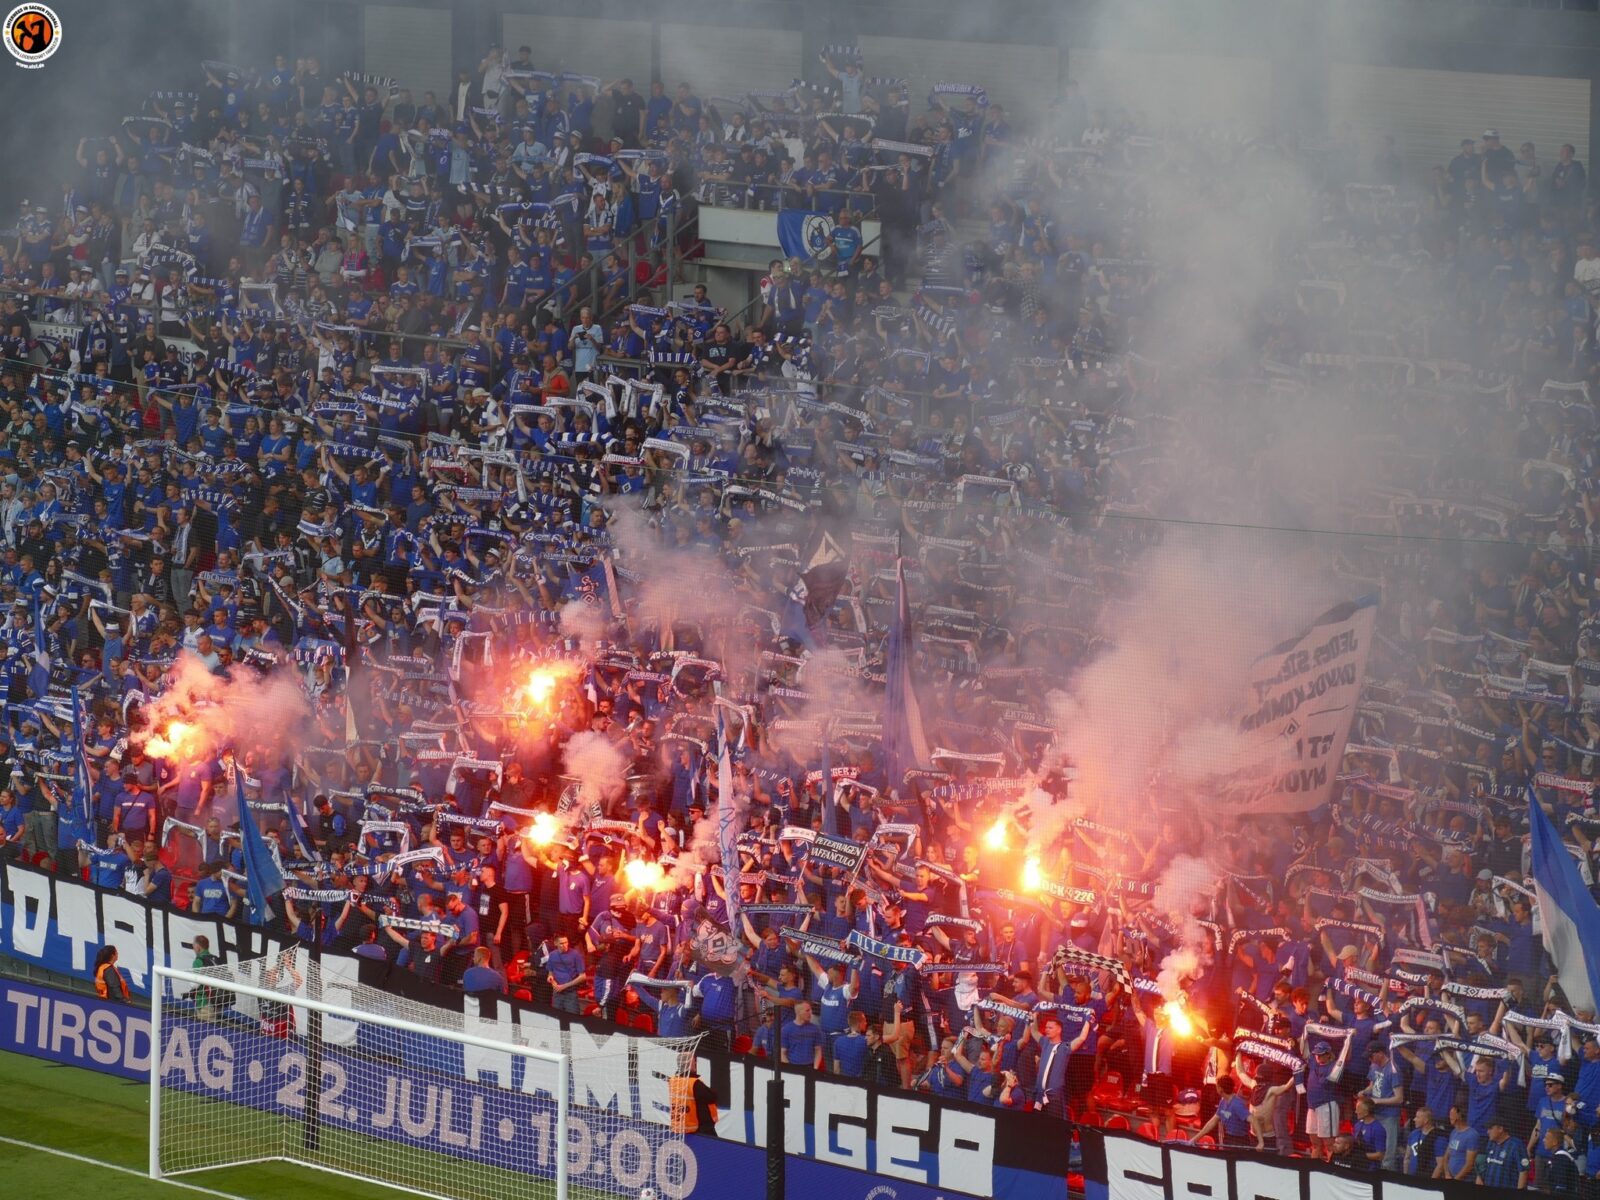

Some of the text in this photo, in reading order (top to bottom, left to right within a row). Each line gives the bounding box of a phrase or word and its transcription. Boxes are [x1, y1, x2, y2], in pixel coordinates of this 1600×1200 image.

[815, 835, 862, 857] PETERWAGEN
[803, 940, 857, 966] CASTAWAYS
[1239, 1040, 1301, 1071] DESCENDANTS
[6, 988, 699, 1198] TIRSDAG 22. JULI 19:00
